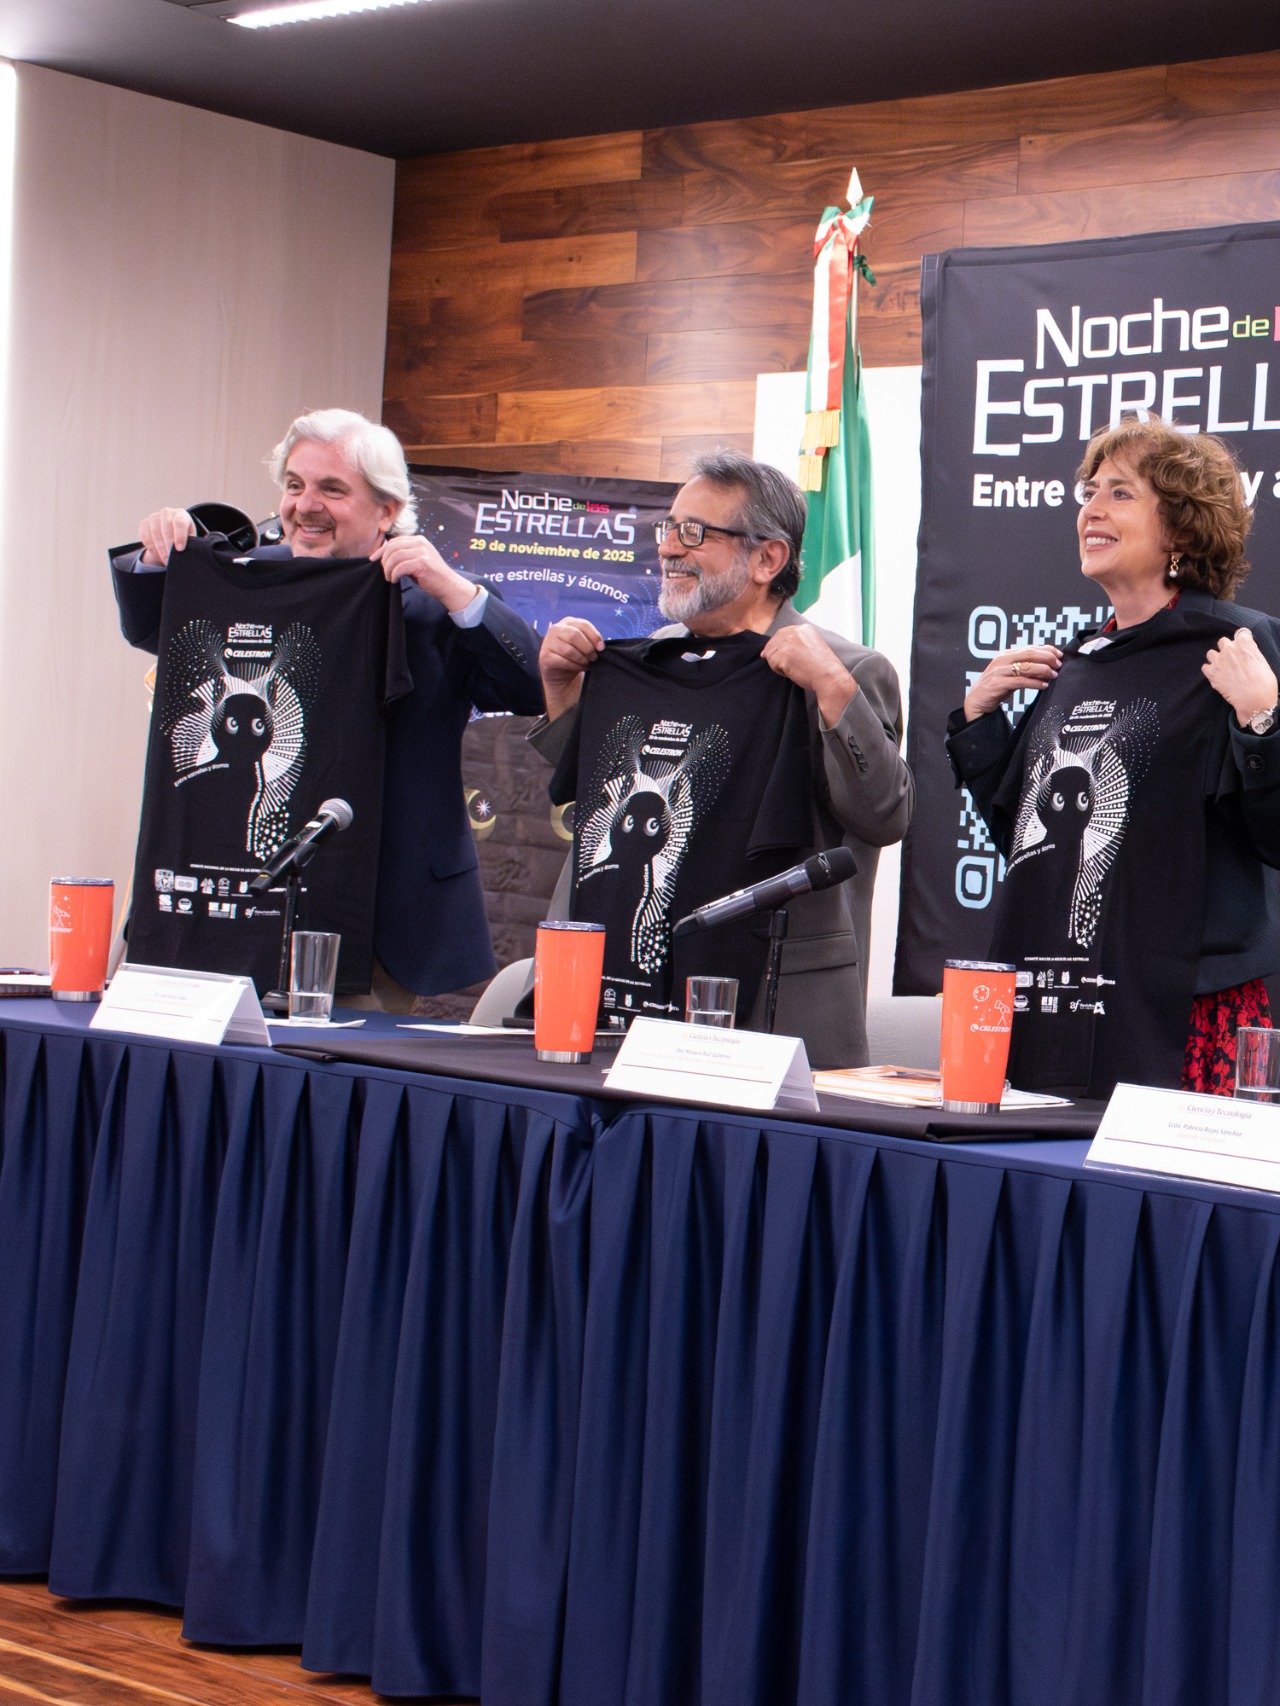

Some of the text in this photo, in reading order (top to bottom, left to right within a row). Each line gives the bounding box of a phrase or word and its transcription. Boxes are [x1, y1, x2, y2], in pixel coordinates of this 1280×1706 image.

[1035, 297, 1230, 369] Noche
[1232, 314, 1269, 338] de
[501, 489, 572, 512] Noche
[586, 501, 610, 514] las
[973, 473, 1065, 507] Entre
[1240, 471, 1264, 507] y
[475, 503, 637, 545] ESTRELLAS
[470, 538, 635, 562] 29 de noviembre de 2025
[507, 569, 565, 583] estrellas
[565, 574, 577, 587] y
[578, 574, 630, 604] átomos
[1187, 1104, 1211, 1115] Ciencia
